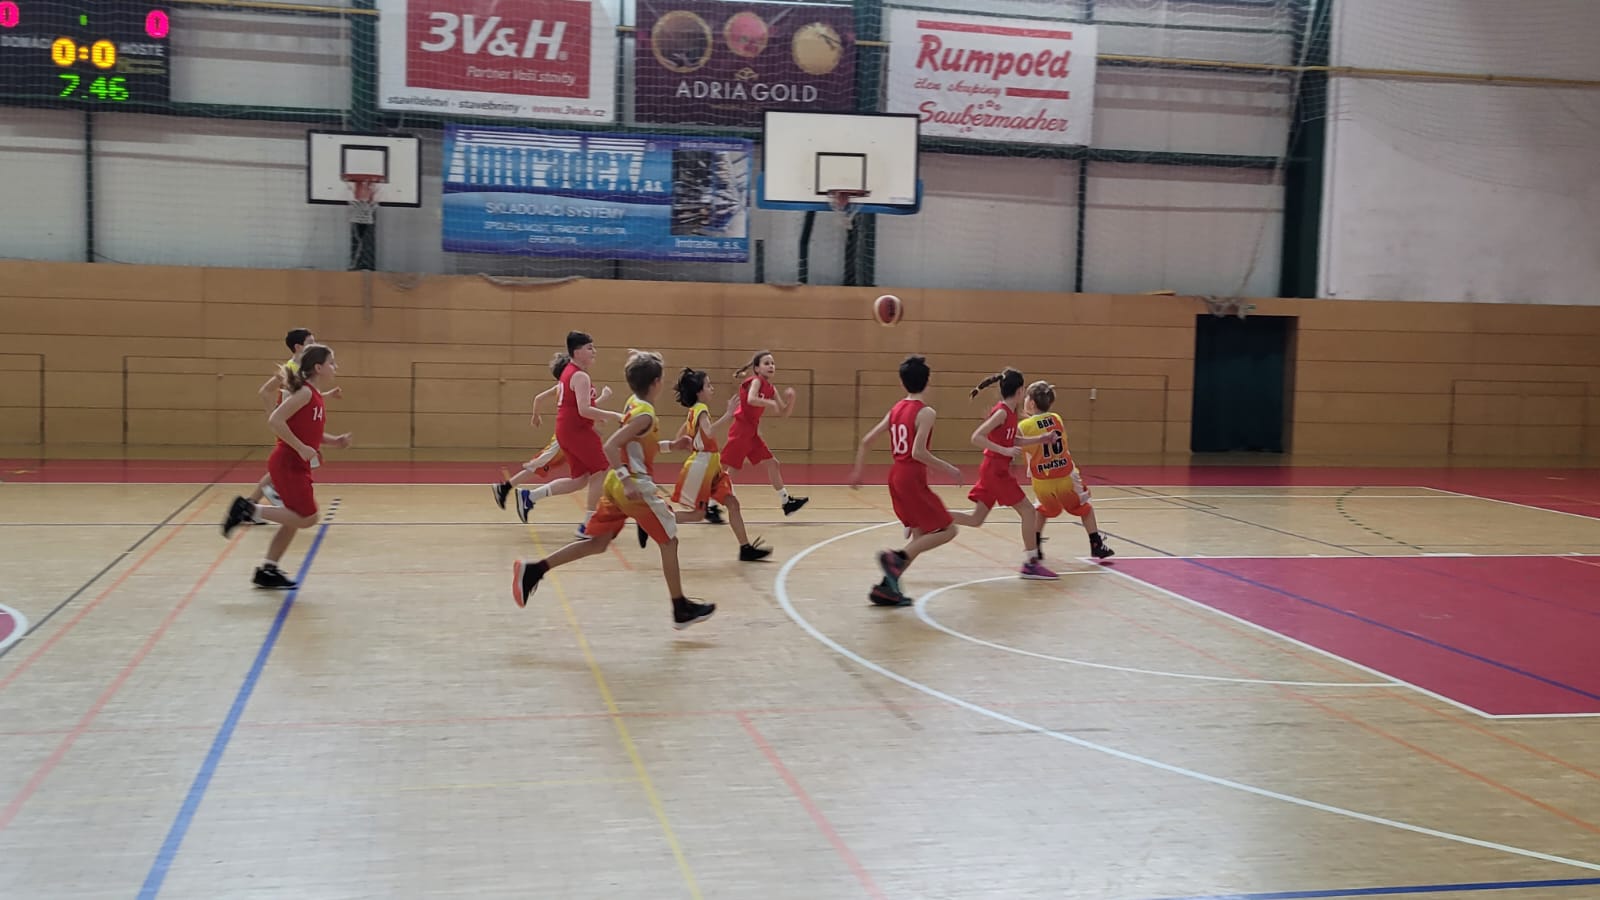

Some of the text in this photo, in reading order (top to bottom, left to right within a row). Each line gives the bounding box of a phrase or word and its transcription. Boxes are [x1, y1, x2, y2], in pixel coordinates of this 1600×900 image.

[144, 9, 170, 39] 0
[915, 34, 1072, 80] Rumpold
[466, 65, 511, 81] Partner
[675, 80, 818, 102] ADRIA GOLD
[918, 100, 1069, 132] Saubermacher
[312, 405, 323, 421] 14
[1036, 417, 1055, 429] BBK
[891, 423, 908, 455] 18
